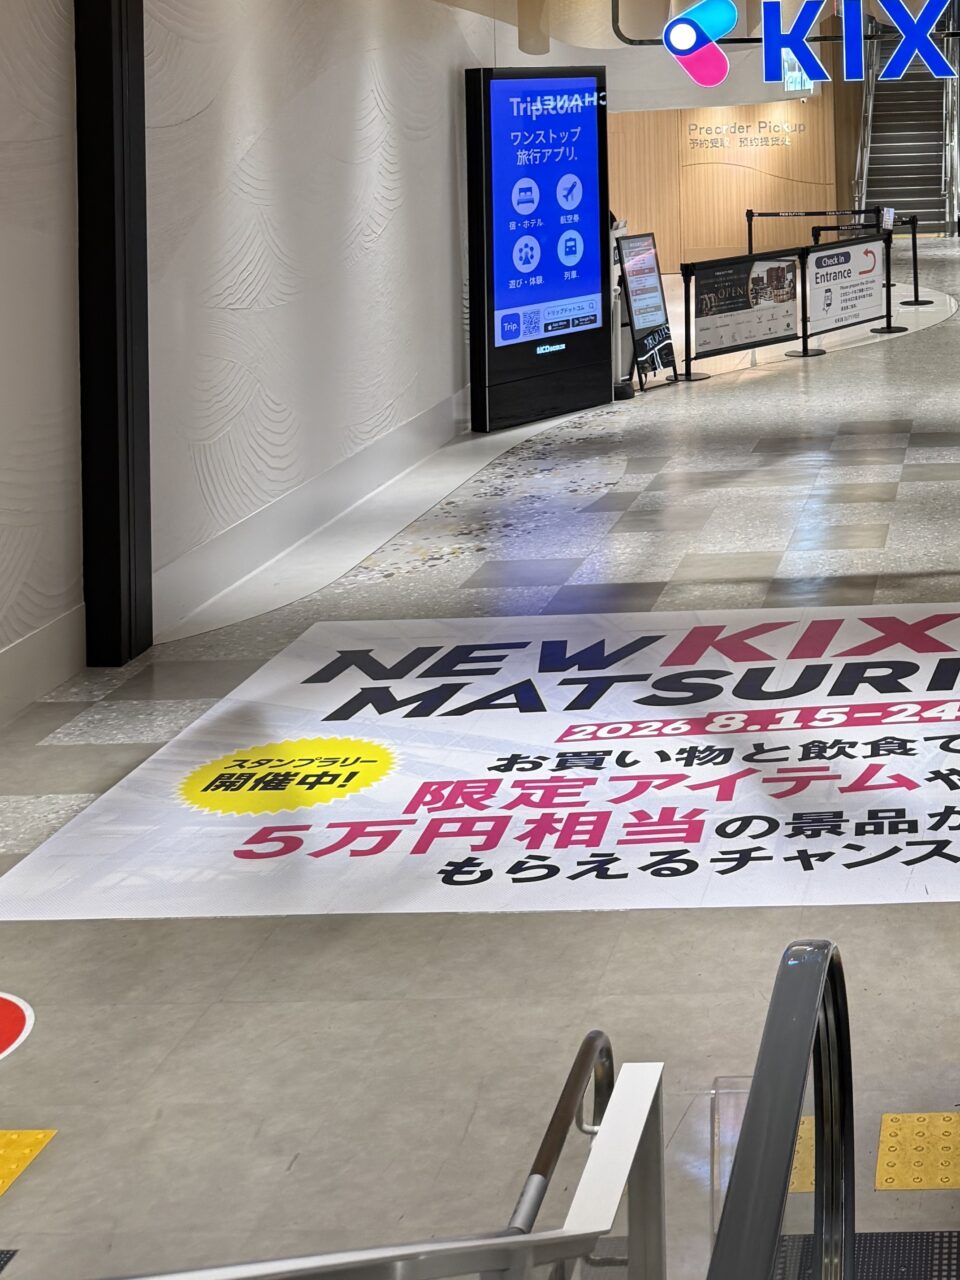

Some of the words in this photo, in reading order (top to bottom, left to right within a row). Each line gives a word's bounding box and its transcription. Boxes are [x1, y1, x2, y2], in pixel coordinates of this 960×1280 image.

[510, 126, 581, 146] ワンストップ
[758, 120, 806, 136] Picup
[821, 255, 839, 266] Check
[815, 268, 852, 285] Entrance
[302, 634, 667, 685] NEW
[568, 719, 693, 740] 2026
[224, 756, 378, 770] スタンプラリー
[200, 770, 359, 792] 開催中!
